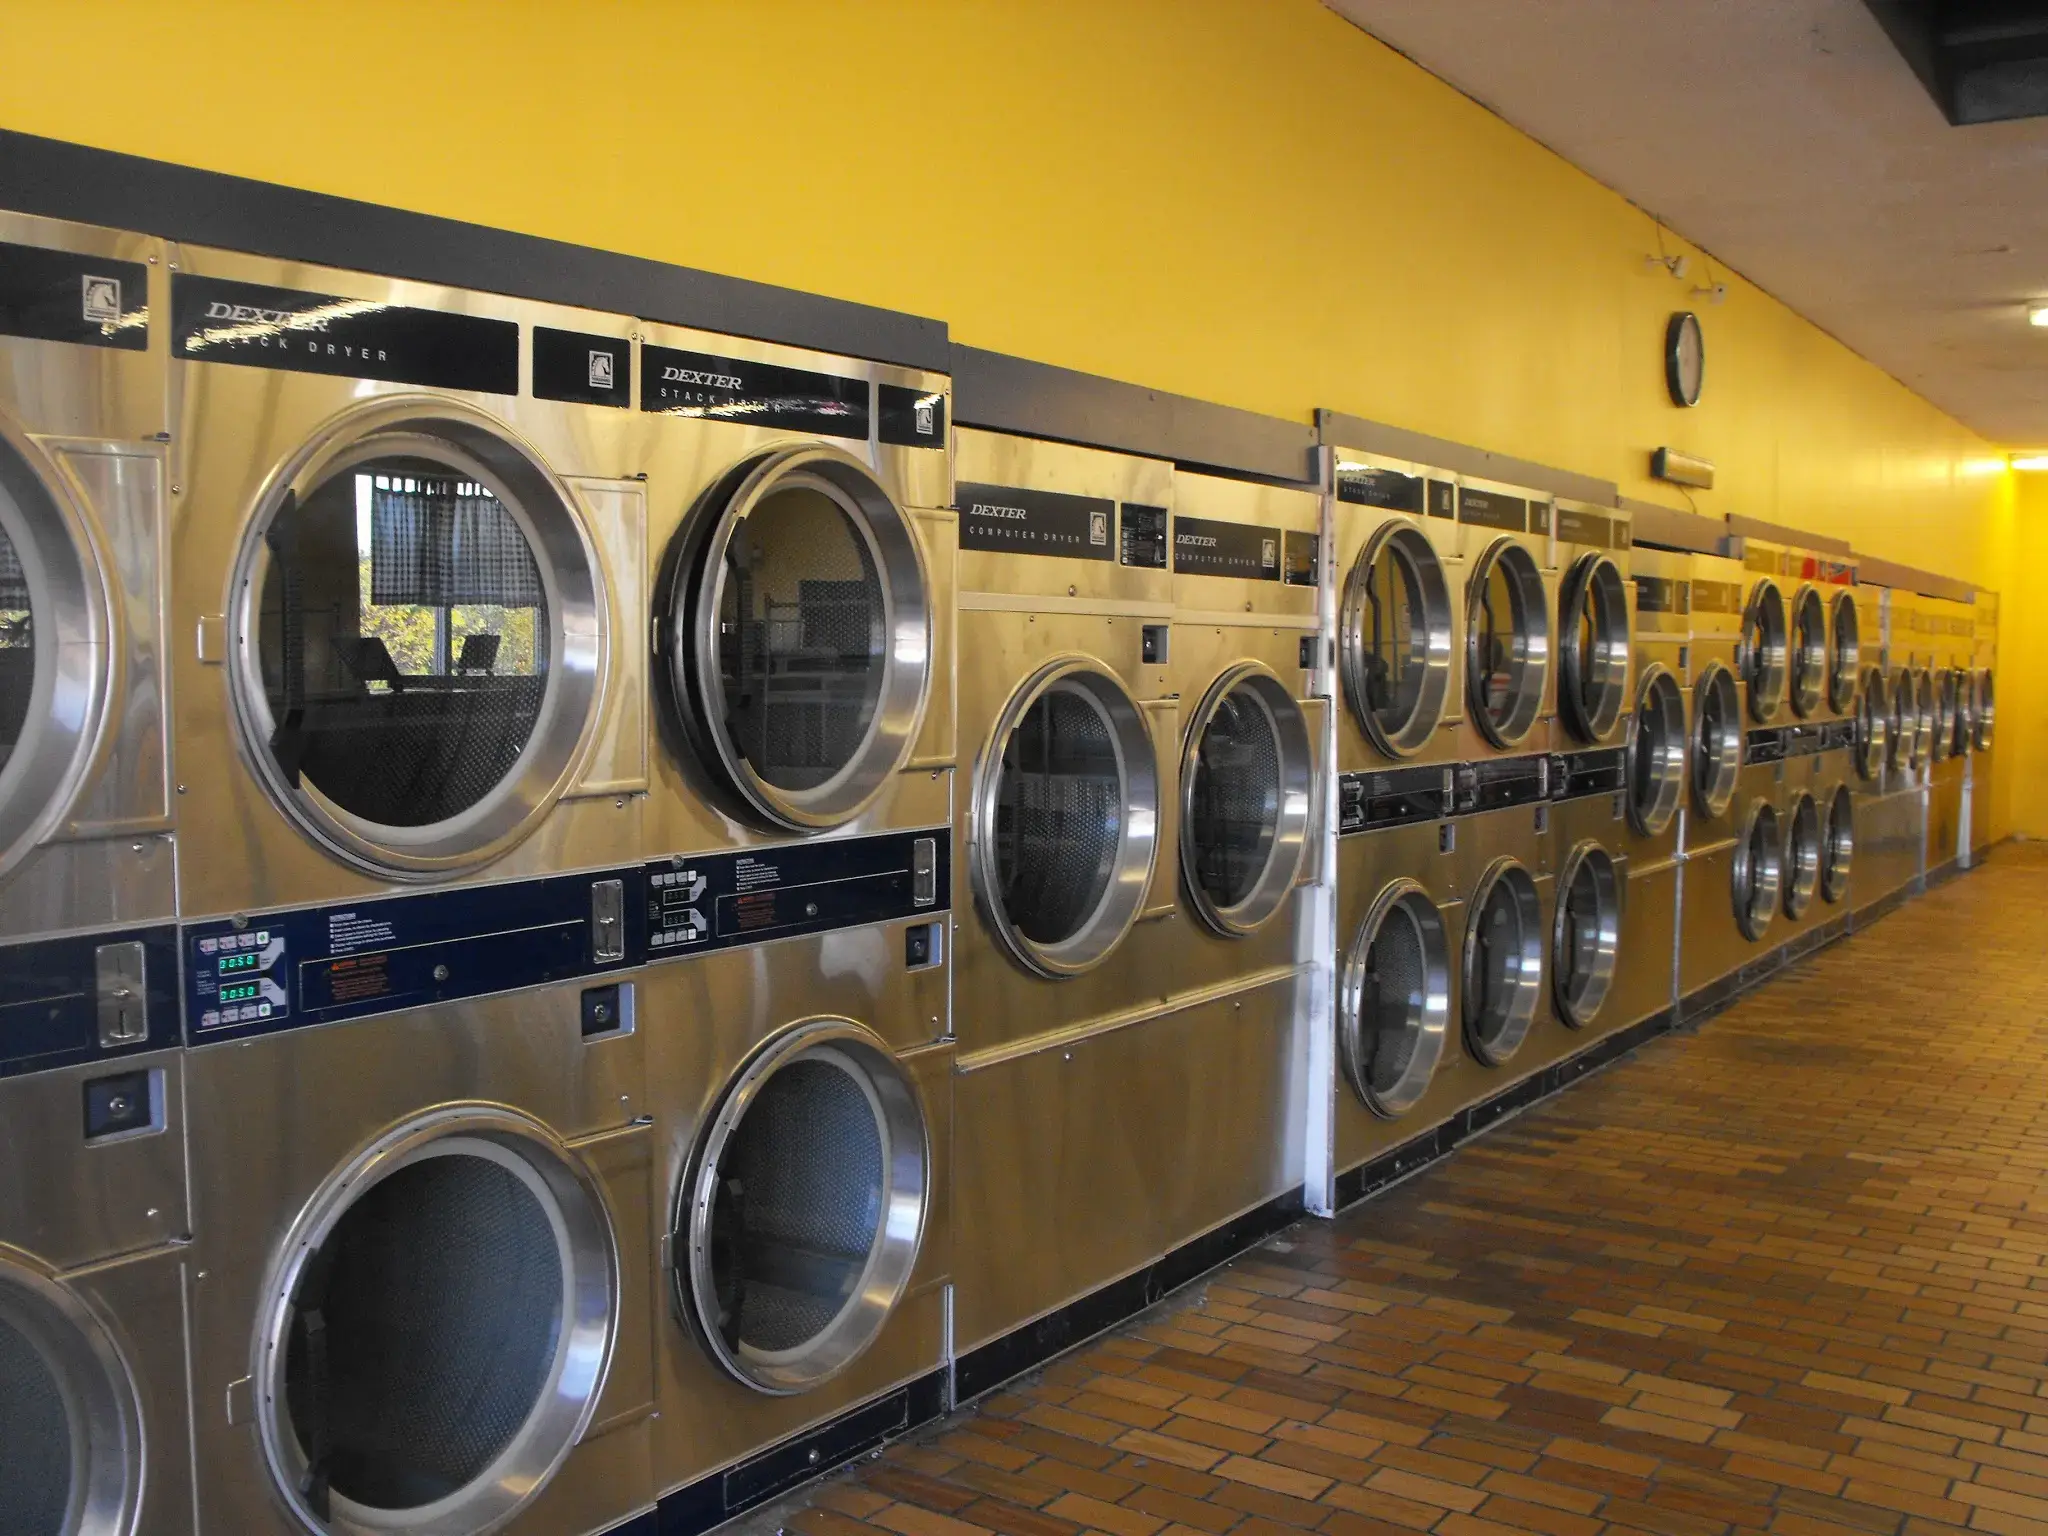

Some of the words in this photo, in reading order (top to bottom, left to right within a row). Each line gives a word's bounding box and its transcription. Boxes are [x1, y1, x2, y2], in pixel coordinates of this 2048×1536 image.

[309, 342, 387, 361] DRYER
[661, 366, 742, 390] DEXTER
[660, 387, 715, 404] STACK
[970, 504, 1027, 519] DEXTER
[969, 526, 1035, 539] COMPUTER
[1043, 533, 1080, 543] DRYER
[1176, 534, 1217, 547] DEXTER
